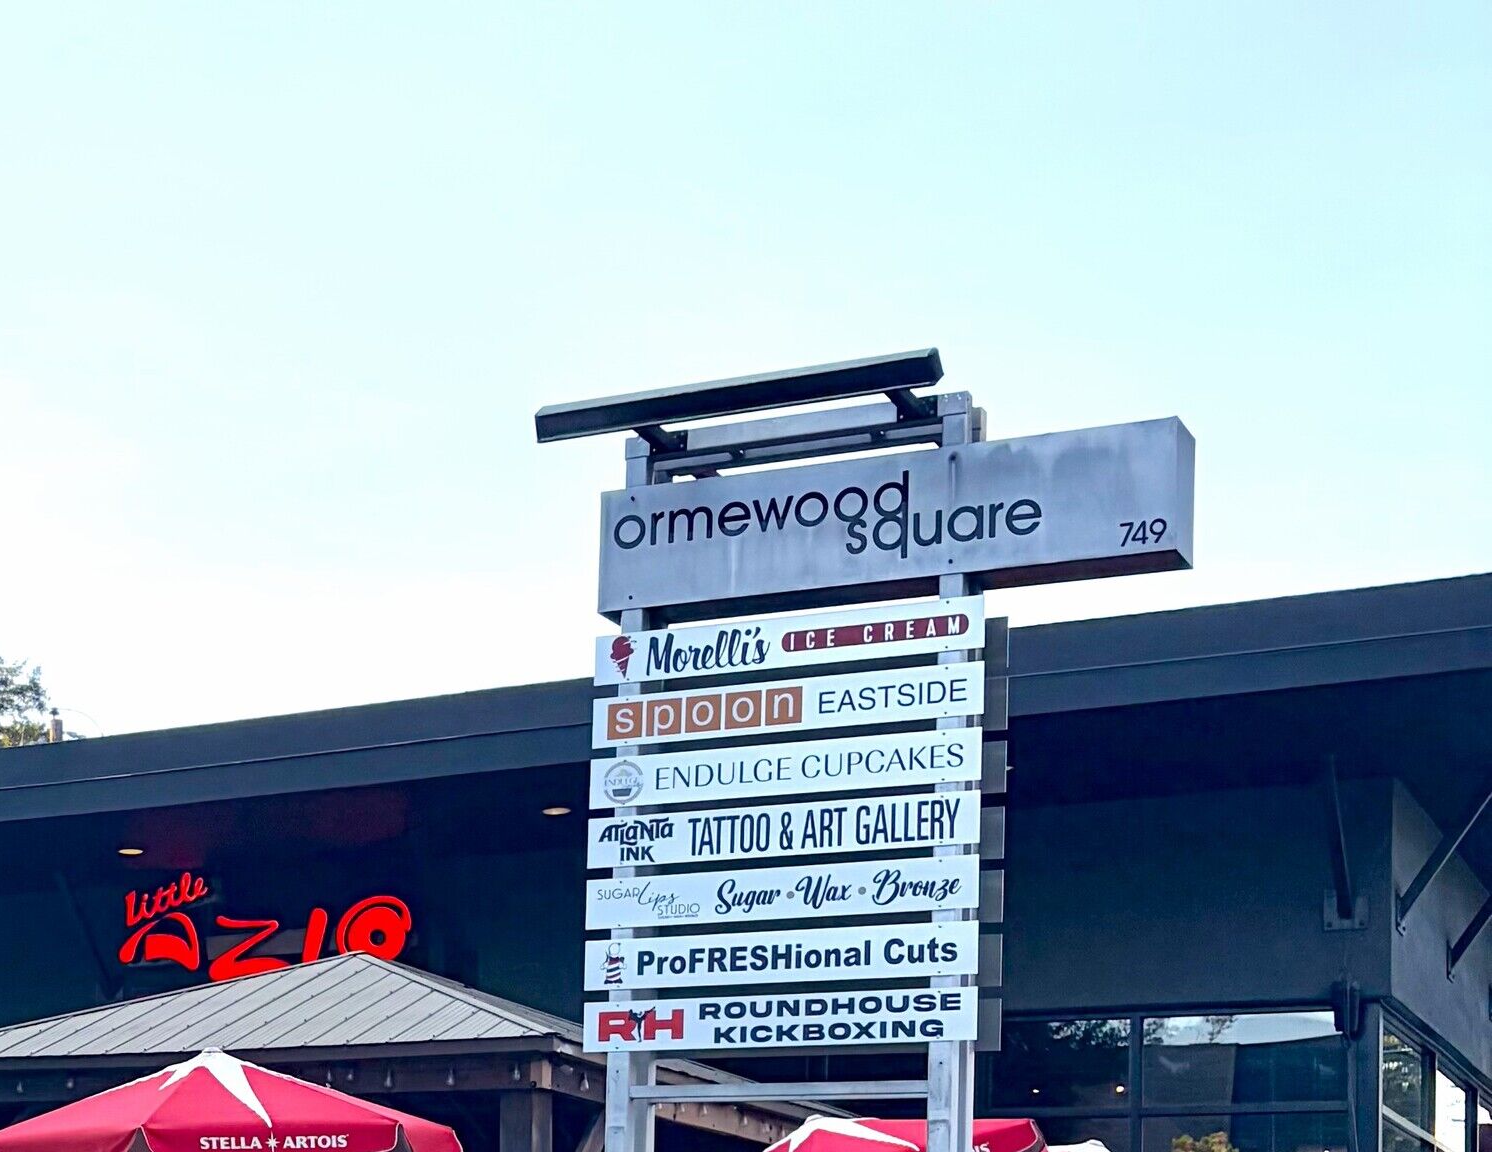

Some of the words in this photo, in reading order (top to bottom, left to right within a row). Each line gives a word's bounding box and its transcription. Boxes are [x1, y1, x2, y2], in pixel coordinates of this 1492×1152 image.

[613, 471, 909, 549] ormewood
[845, 498, 1042, 559] square
[1119, 517, 1168, 548] 749
[646, 627, 770, 676] Morelli's
[789, 628, 835, 649] ICE
[863, 616, 961, 642] CREAM
[615, 692, 795, 737] spoon
[818, 678, 968, 714] EASTSIDE
[655, 756, 792, 790] ENDULGE
[801, 742, 964, 778] CUPCAKES
[689, 811, 769, 856] TATTOO
[778, 811, 794, 850] &
[801, 805, 847, 849] ART
[856, 798, 961, 845] GALLERY
[620, 845, 656, 863] INK
[597, 887, 641, 901] SUGAR
[638, 881, 680, 912] Lips
[657, 903, 701, 916] STUDIO
[715, 879, 781, 915] Sugar
[795, 874, 852, 909] Wax
[872, 869, 961, 906] Bronze
[637, 940, 871, 976] ProFRESHional
[883, 937, 958, 964] Cuts
[698, 993, 961, 1020] ROUNDHOUSE
[598, 1008, 684, 1042] RH
[713, 1020, 944, 1044] KICKBOXING
[200, 1137, 262, 1150] STELLA
[283, 1134, 347, 1149] ARTOIS
